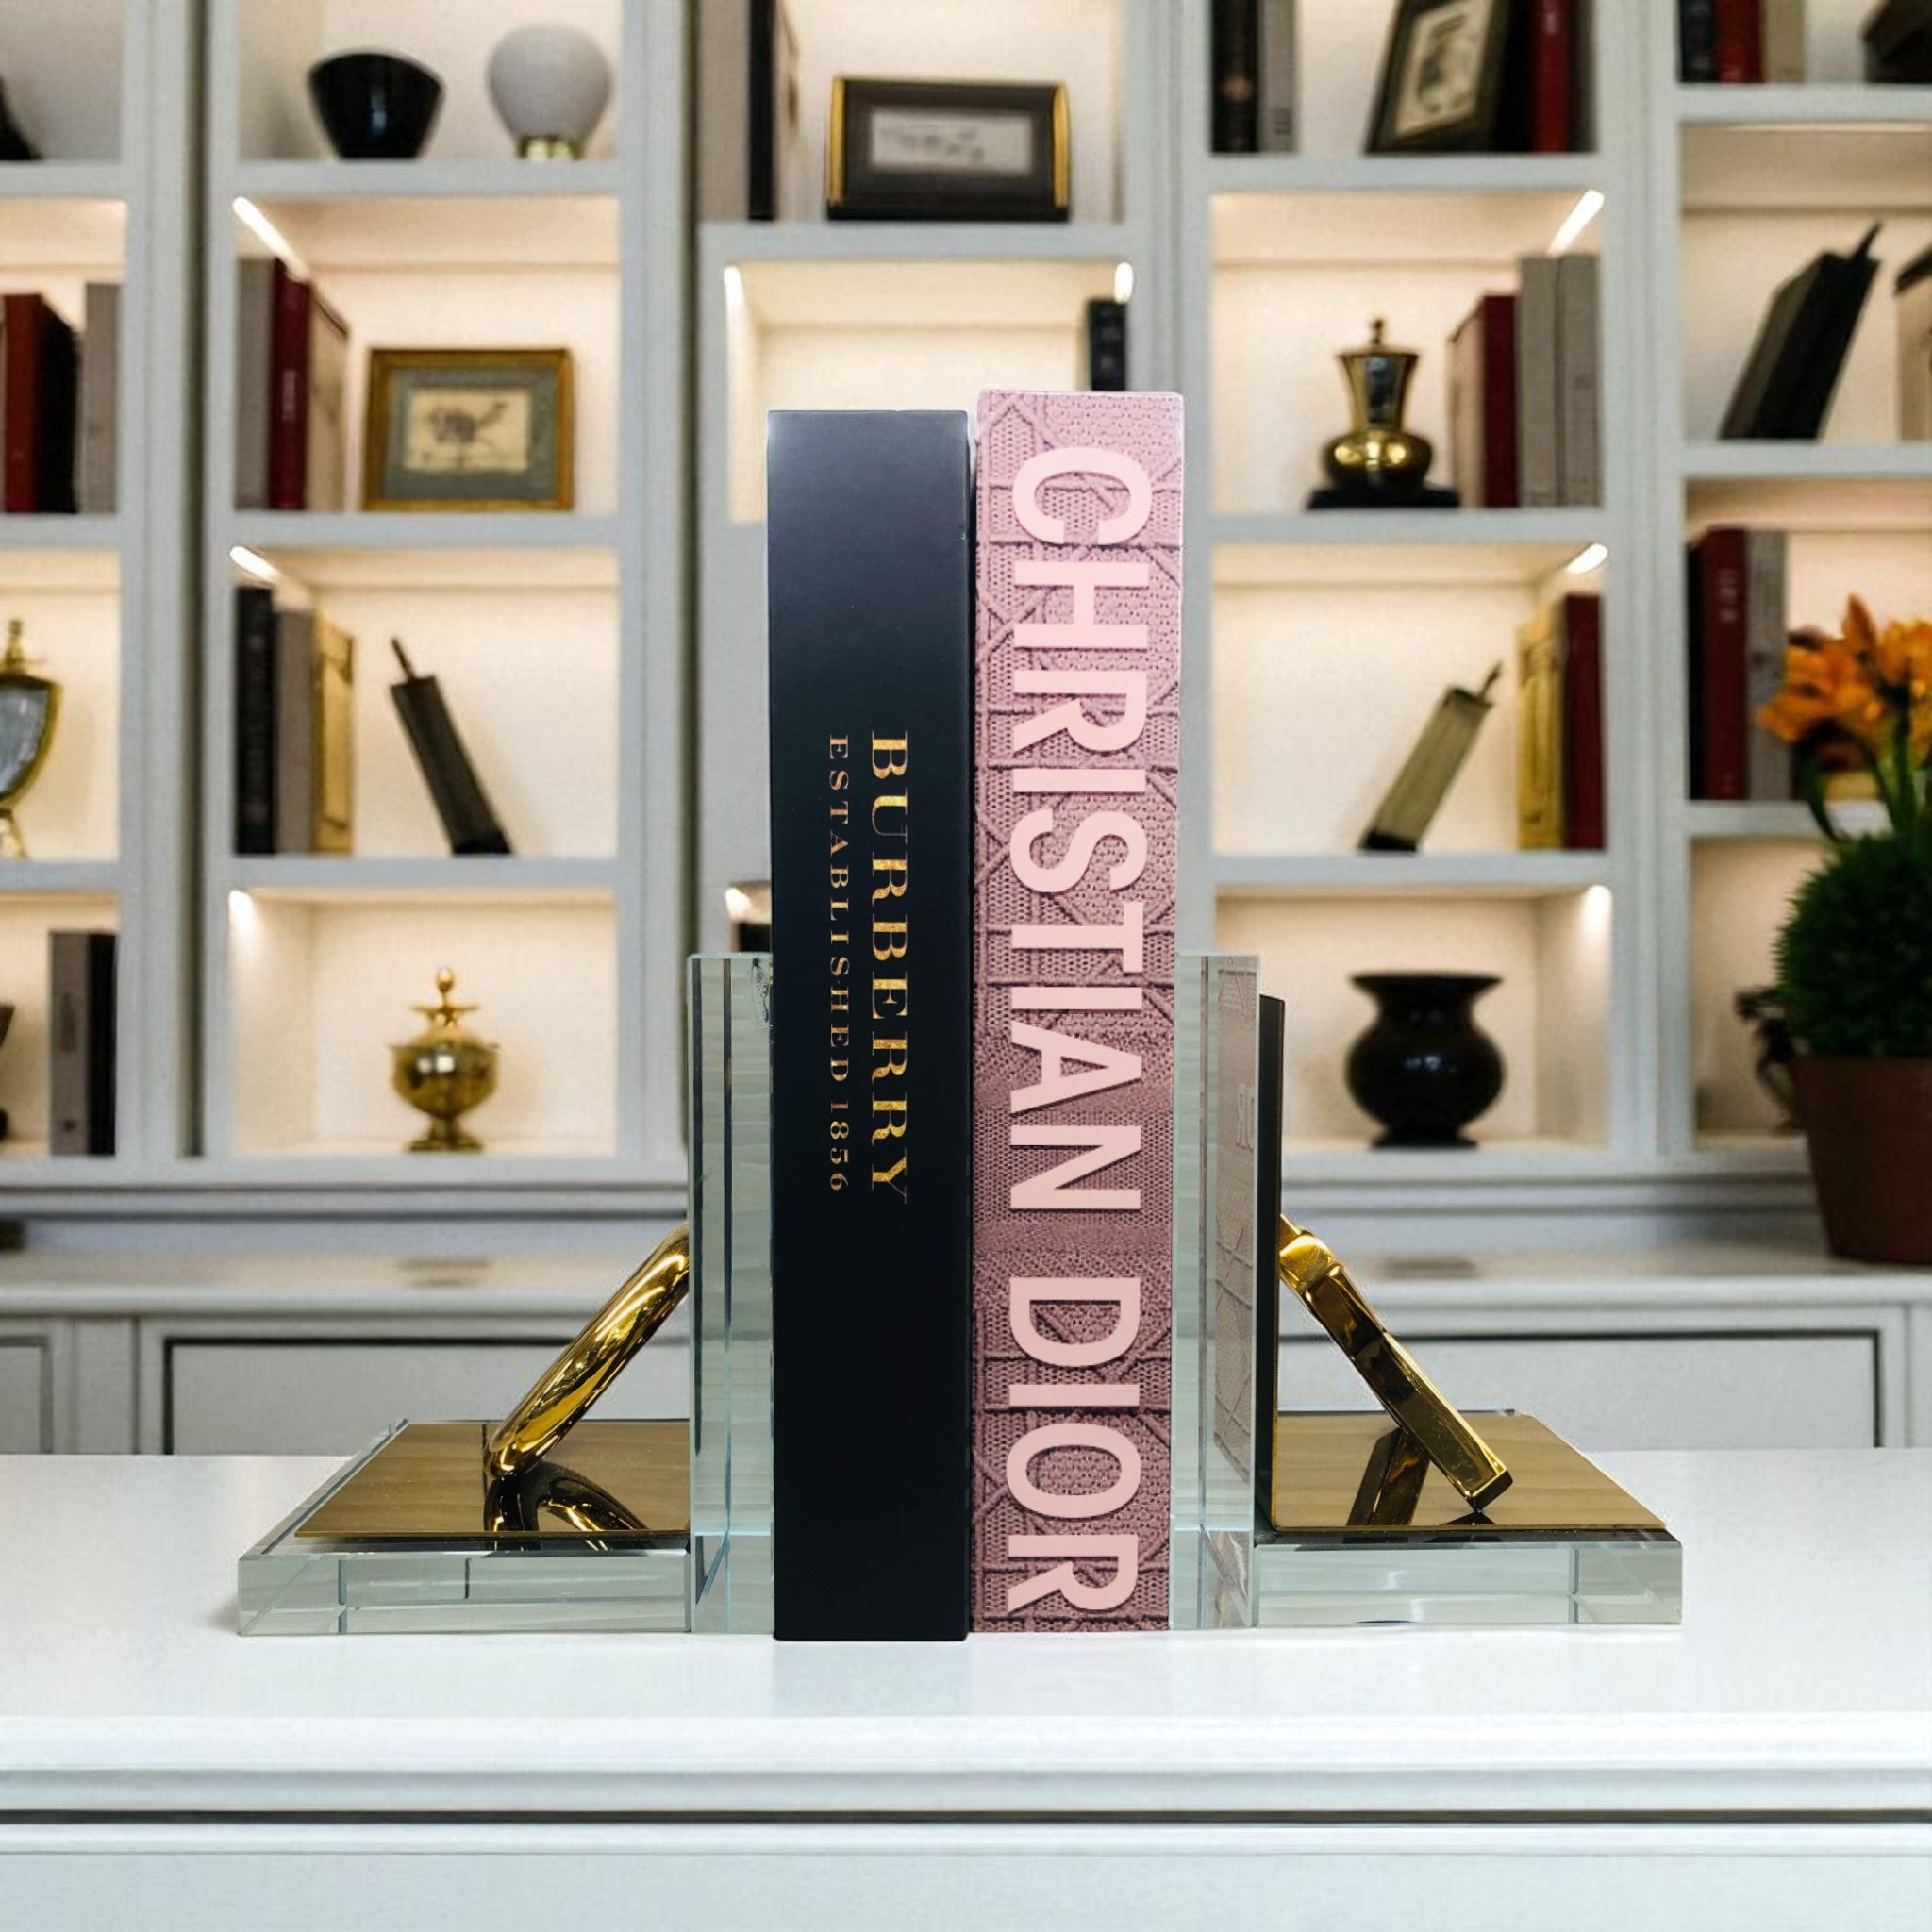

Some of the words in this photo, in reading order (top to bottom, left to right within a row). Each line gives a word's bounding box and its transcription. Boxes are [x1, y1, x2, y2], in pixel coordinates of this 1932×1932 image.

[829, 734, 849, 1082] ESTABLISHED
[871, 731, 908, 1203] BURBERRY
[1009, 448, 1152, 1209] CHRISTIAN
[829, 1099, 849, 1191] 1856
[1006, 1278, 1142, 1612] DIOR
